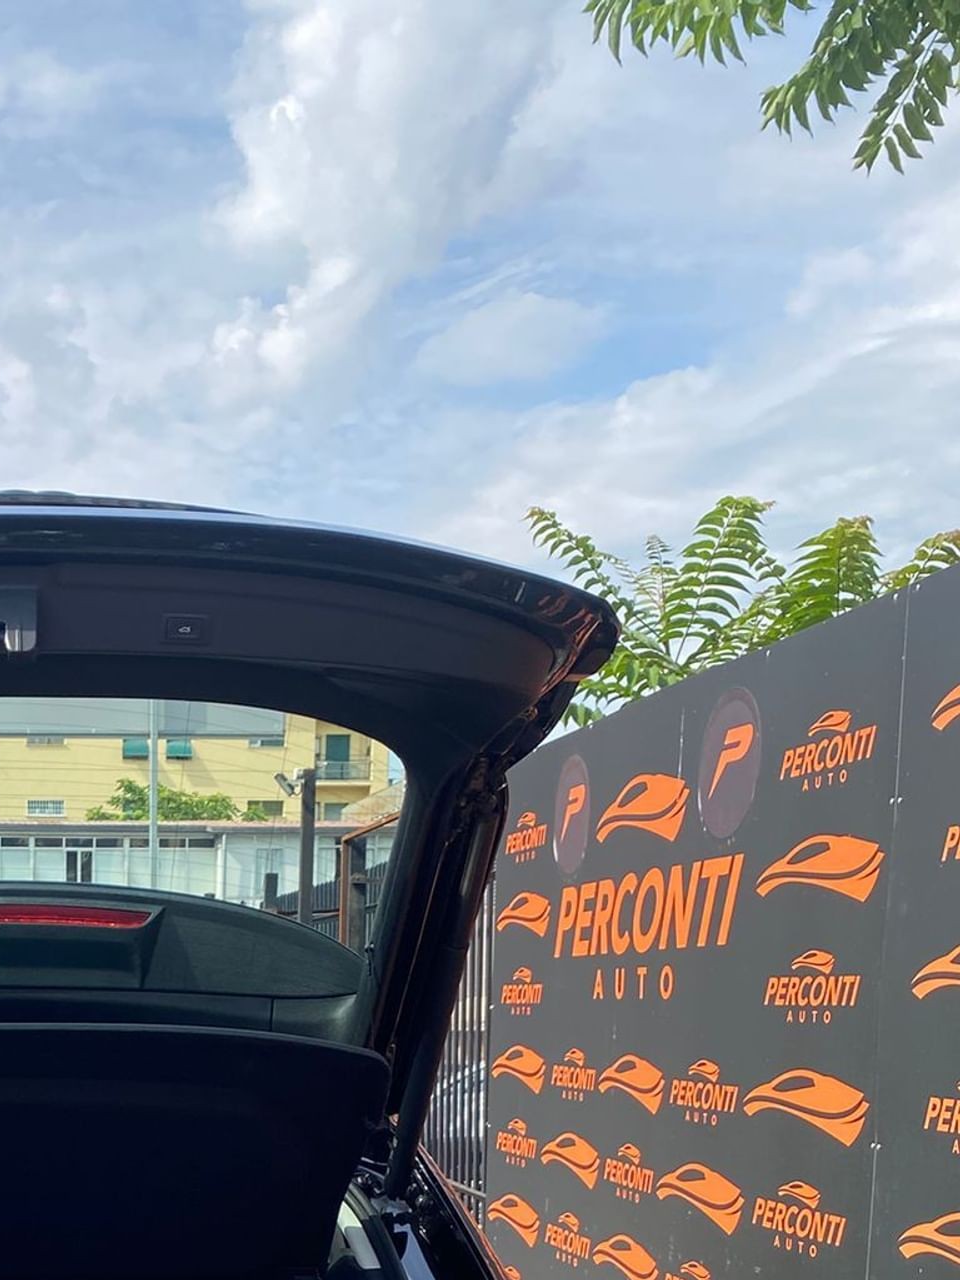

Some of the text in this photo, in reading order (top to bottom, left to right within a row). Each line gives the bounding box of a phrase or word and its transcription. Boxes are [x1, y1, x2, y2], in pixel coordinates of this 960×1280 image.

[780, 725, 877, 781] PERCONTI
[802, 769, 847, 792] AUTO
[505, 823, 548, 855] PERCONTI
[553, 853, 745, 958] PERCONTI
[501, 983, 543, 1005] PERCONTI
[592, 964, 674, 1001] AUTO
[763, 975, 861, 1007] PERCONTI
[786, 1010, 832, 1025] AUTO
[551, 1064, 596, 1091] PERCONTI
[669, 1079, 739, 1113] PERCONTI
[685, 1110, 718, 1126] AUTO
[495, 1130, 538, 1159] PERCONTI
[603, 1158, 654, 1194] PERCONTI
[751, 1197, 847, 1247] PERCONTI
[544, 1223, 592, 1260] PERCONTI
[773, 1234, 818, 1258] AUTO
